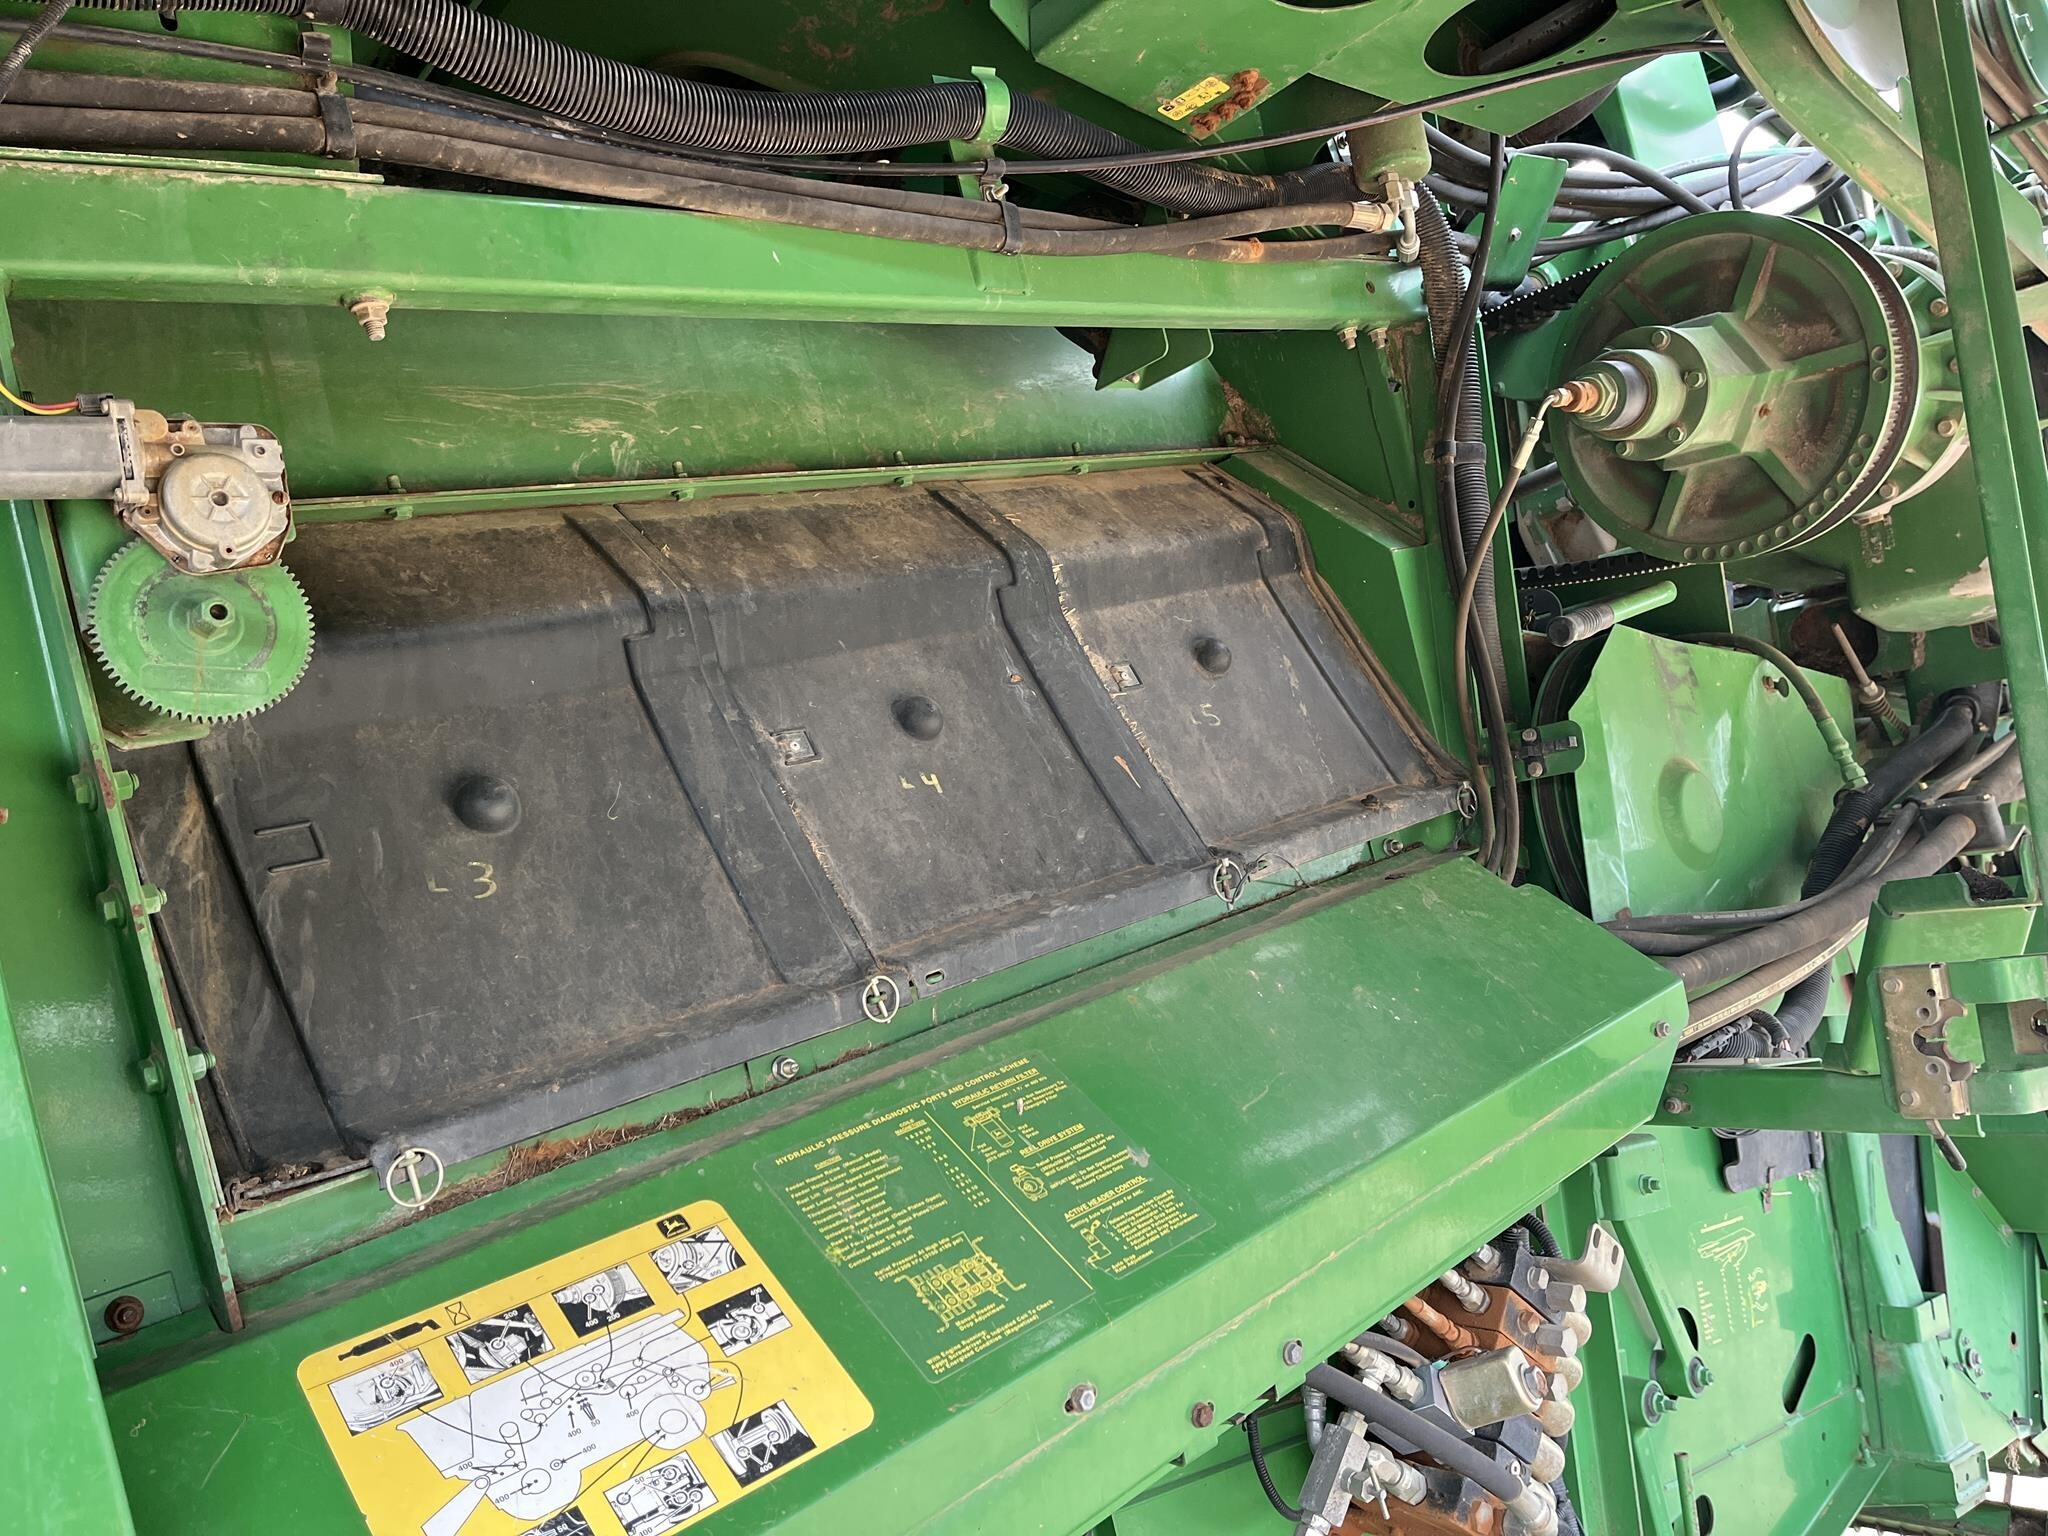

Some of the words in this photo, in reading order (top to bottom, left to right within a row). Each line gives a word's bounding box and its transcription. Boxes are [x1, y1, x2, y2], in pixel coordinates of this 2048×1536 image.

[950, 1086, 991, 1106] HYDRAULIC
[988, 1076, 1017, 1091] RETURN
[1014, 1067, 1039, 1080] FILTER
[773, 1140, 827, 1165] HYDRAULIC
[824, 1121, 872, 1144] PRESSURE
[870, 1101, 921, 1126] DIAGNOSTIC
[919, 1090, 948, 1105] PORTS
[963, 1069, 1001, 1088] CONTROL
[998, 1057, 1031, 1073] SCHEME
[1018, 1143, 1039, 1156] REEL
[1036, 1134, 1059, 1147] DRIVE
[1056, 1122, 1084, 1138] SYSTEM
[784, 1180, 806, 1192] Feeder
[841, 1155, 865, 1168] (Manual
[863, 1148, 882, 1158] Mode)
[790, 1187, 812, 1199] Feeder
[847, 1161, 872, 1174] (Manual
[870, 1154, 889, 1164] Mode)
[1062, 1202, 1090, 1219] ACTIVE
[1086, 1189, 1116, 1207] HEADER
[1112, 1174, 1146, 1194] CONTROL
[503, 1310, 518, 1320] 200
[606, 1312, 621, 1323] 200
[954, 1312, 976, 1327] Manual
[974, 1302, 997, 1316] Header
[957, 1320, 975, 1332] Drop
[972, 1303, 1007, 1324] Adjustment
[585, 1319, 599, 1329] 400
[929, 1357, 949, 1371] Apply
[947, 1338, 983, 1361] Screwdriver
[989, 1319, 1018, 1337] Indicated
[1015, 1312, 1030, 1323] Coil
[1035, 1298, 1055, 1312] Check
[973, 1333, 1004, 1353] Condition
[925, 1354, 942, 1366] With
[939, 1343, 962, 1358] Engine
[625, 1409, 640, 1419] 400
[590, 1419, 601, 1428] 50
[567, 1428, 582, 1438] 400
[582, 1443, 597, 1454] 400
[458, 1462, 473, 1472] 400
[759, 1463, 774, 1474] 400
[634, 1475, 645, 1485] 50
[494, 1494, 510, 1504] 400
